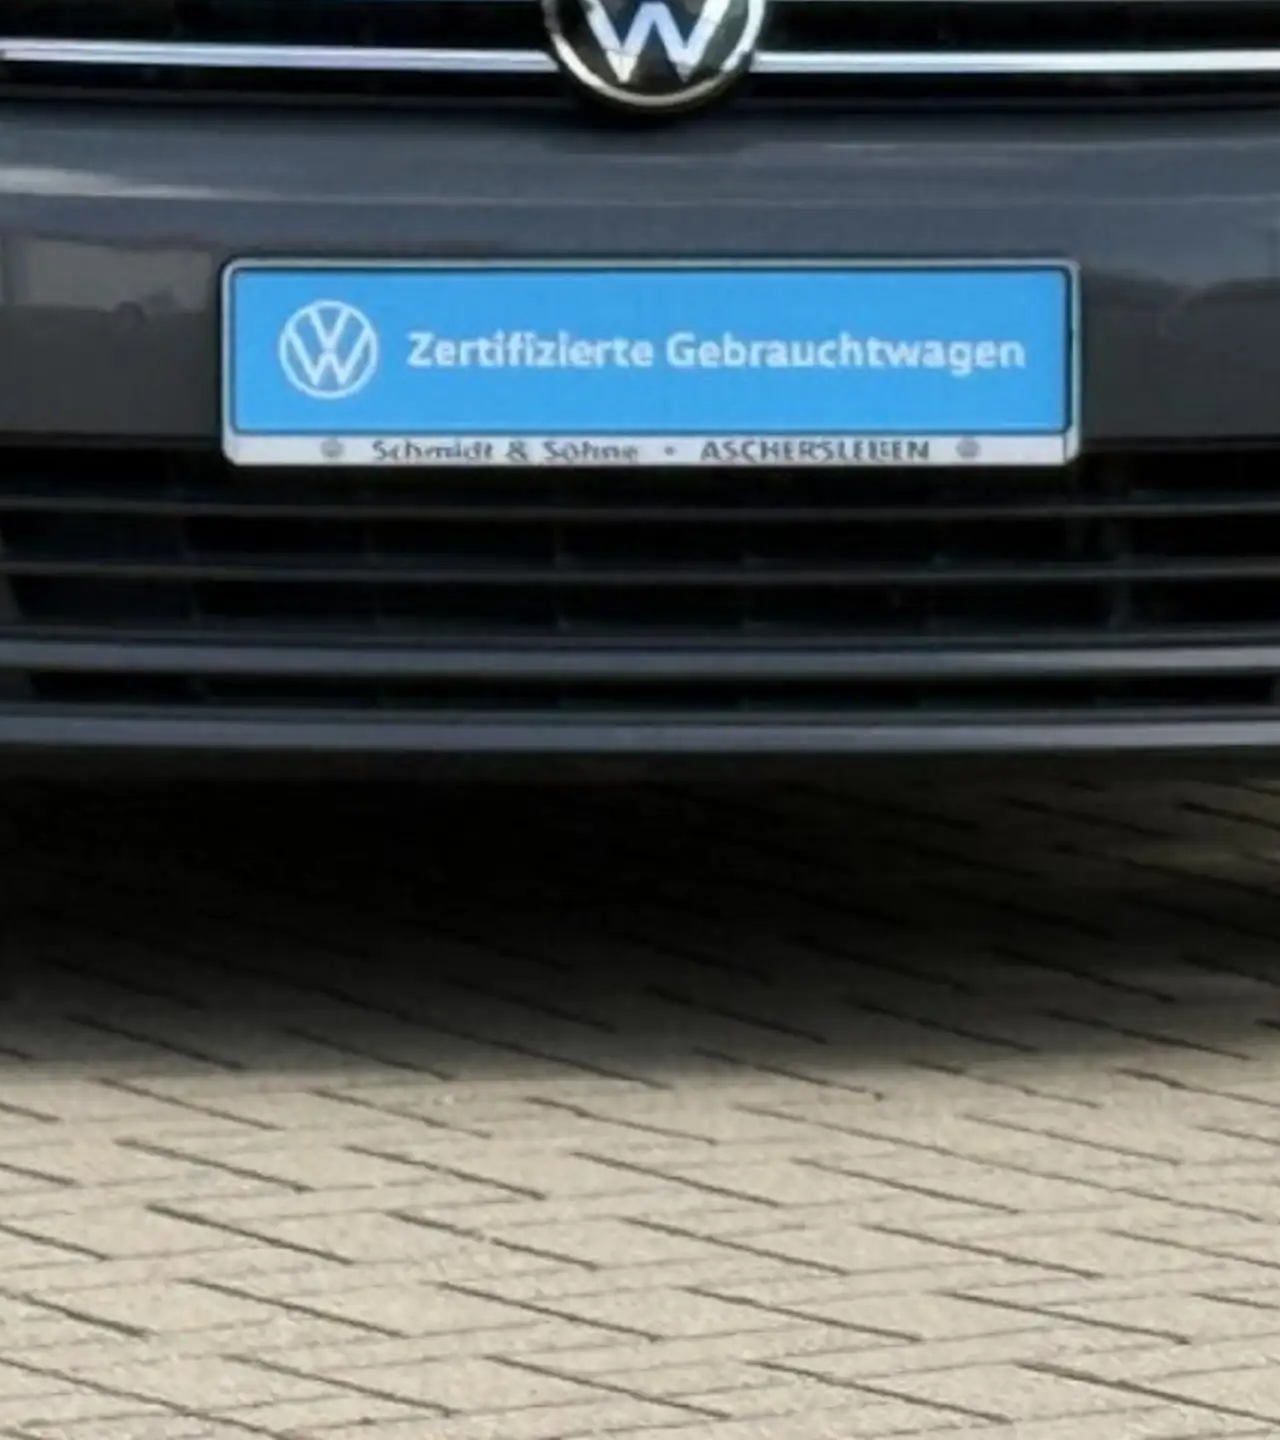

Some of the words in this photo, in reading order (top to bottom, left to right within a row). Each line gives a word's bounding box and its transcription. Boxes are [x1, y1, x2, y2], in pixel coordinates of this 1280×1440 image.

[282, 303, 377, 388] VW
[406, 328, 654, 368] Zertifizierte
[665, 331, 1026, 378] Gebrauchtwagen
[372, 439, 494, 461] Schmidt
